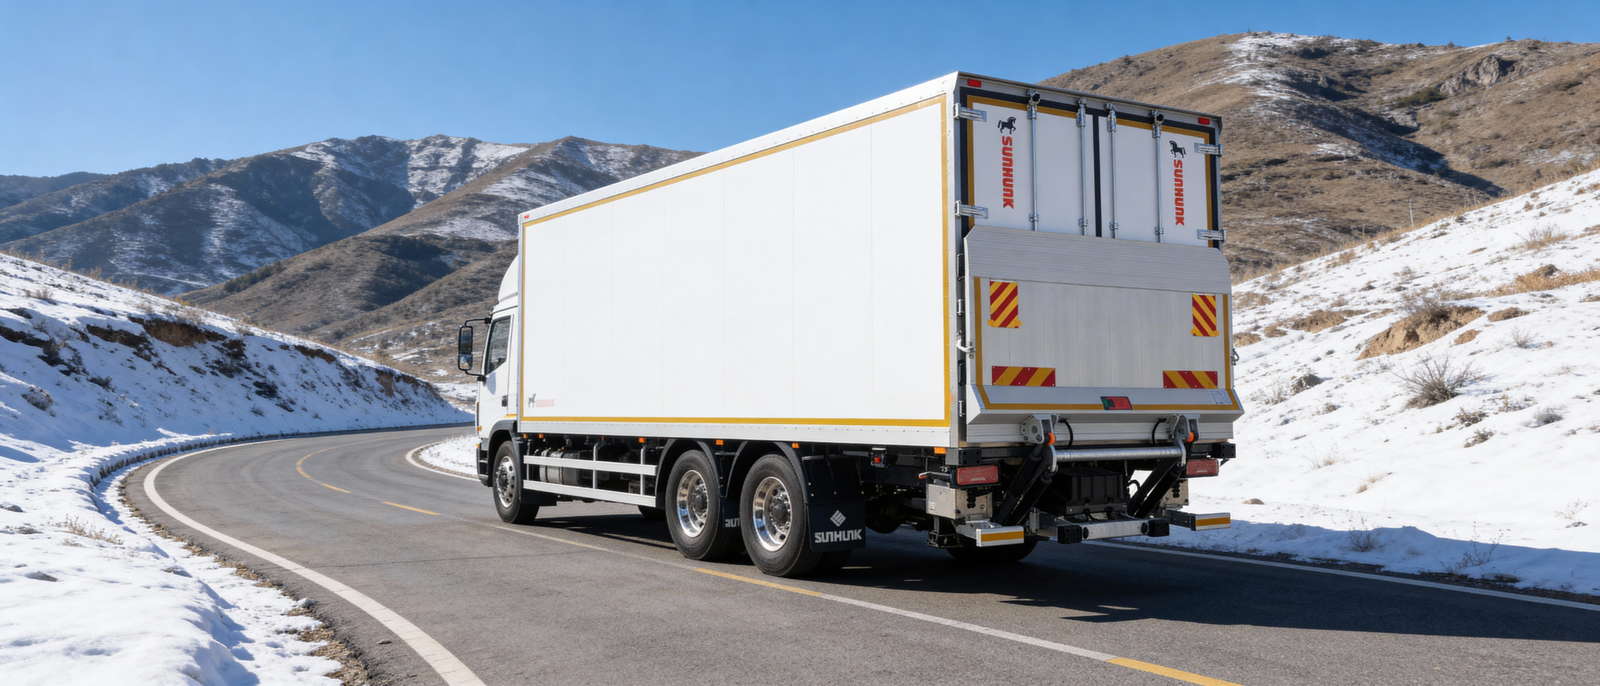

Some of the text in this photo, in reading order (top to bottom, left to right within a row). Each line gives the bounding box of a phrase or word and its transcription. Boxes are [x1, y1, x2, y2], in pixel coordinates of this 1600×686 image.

[1001, 135, 1014, 209] SUNHUNK
[1173, 159, 1185, 226] SUNHUNK
[814, 529, 862, 543] SUNHUNK
